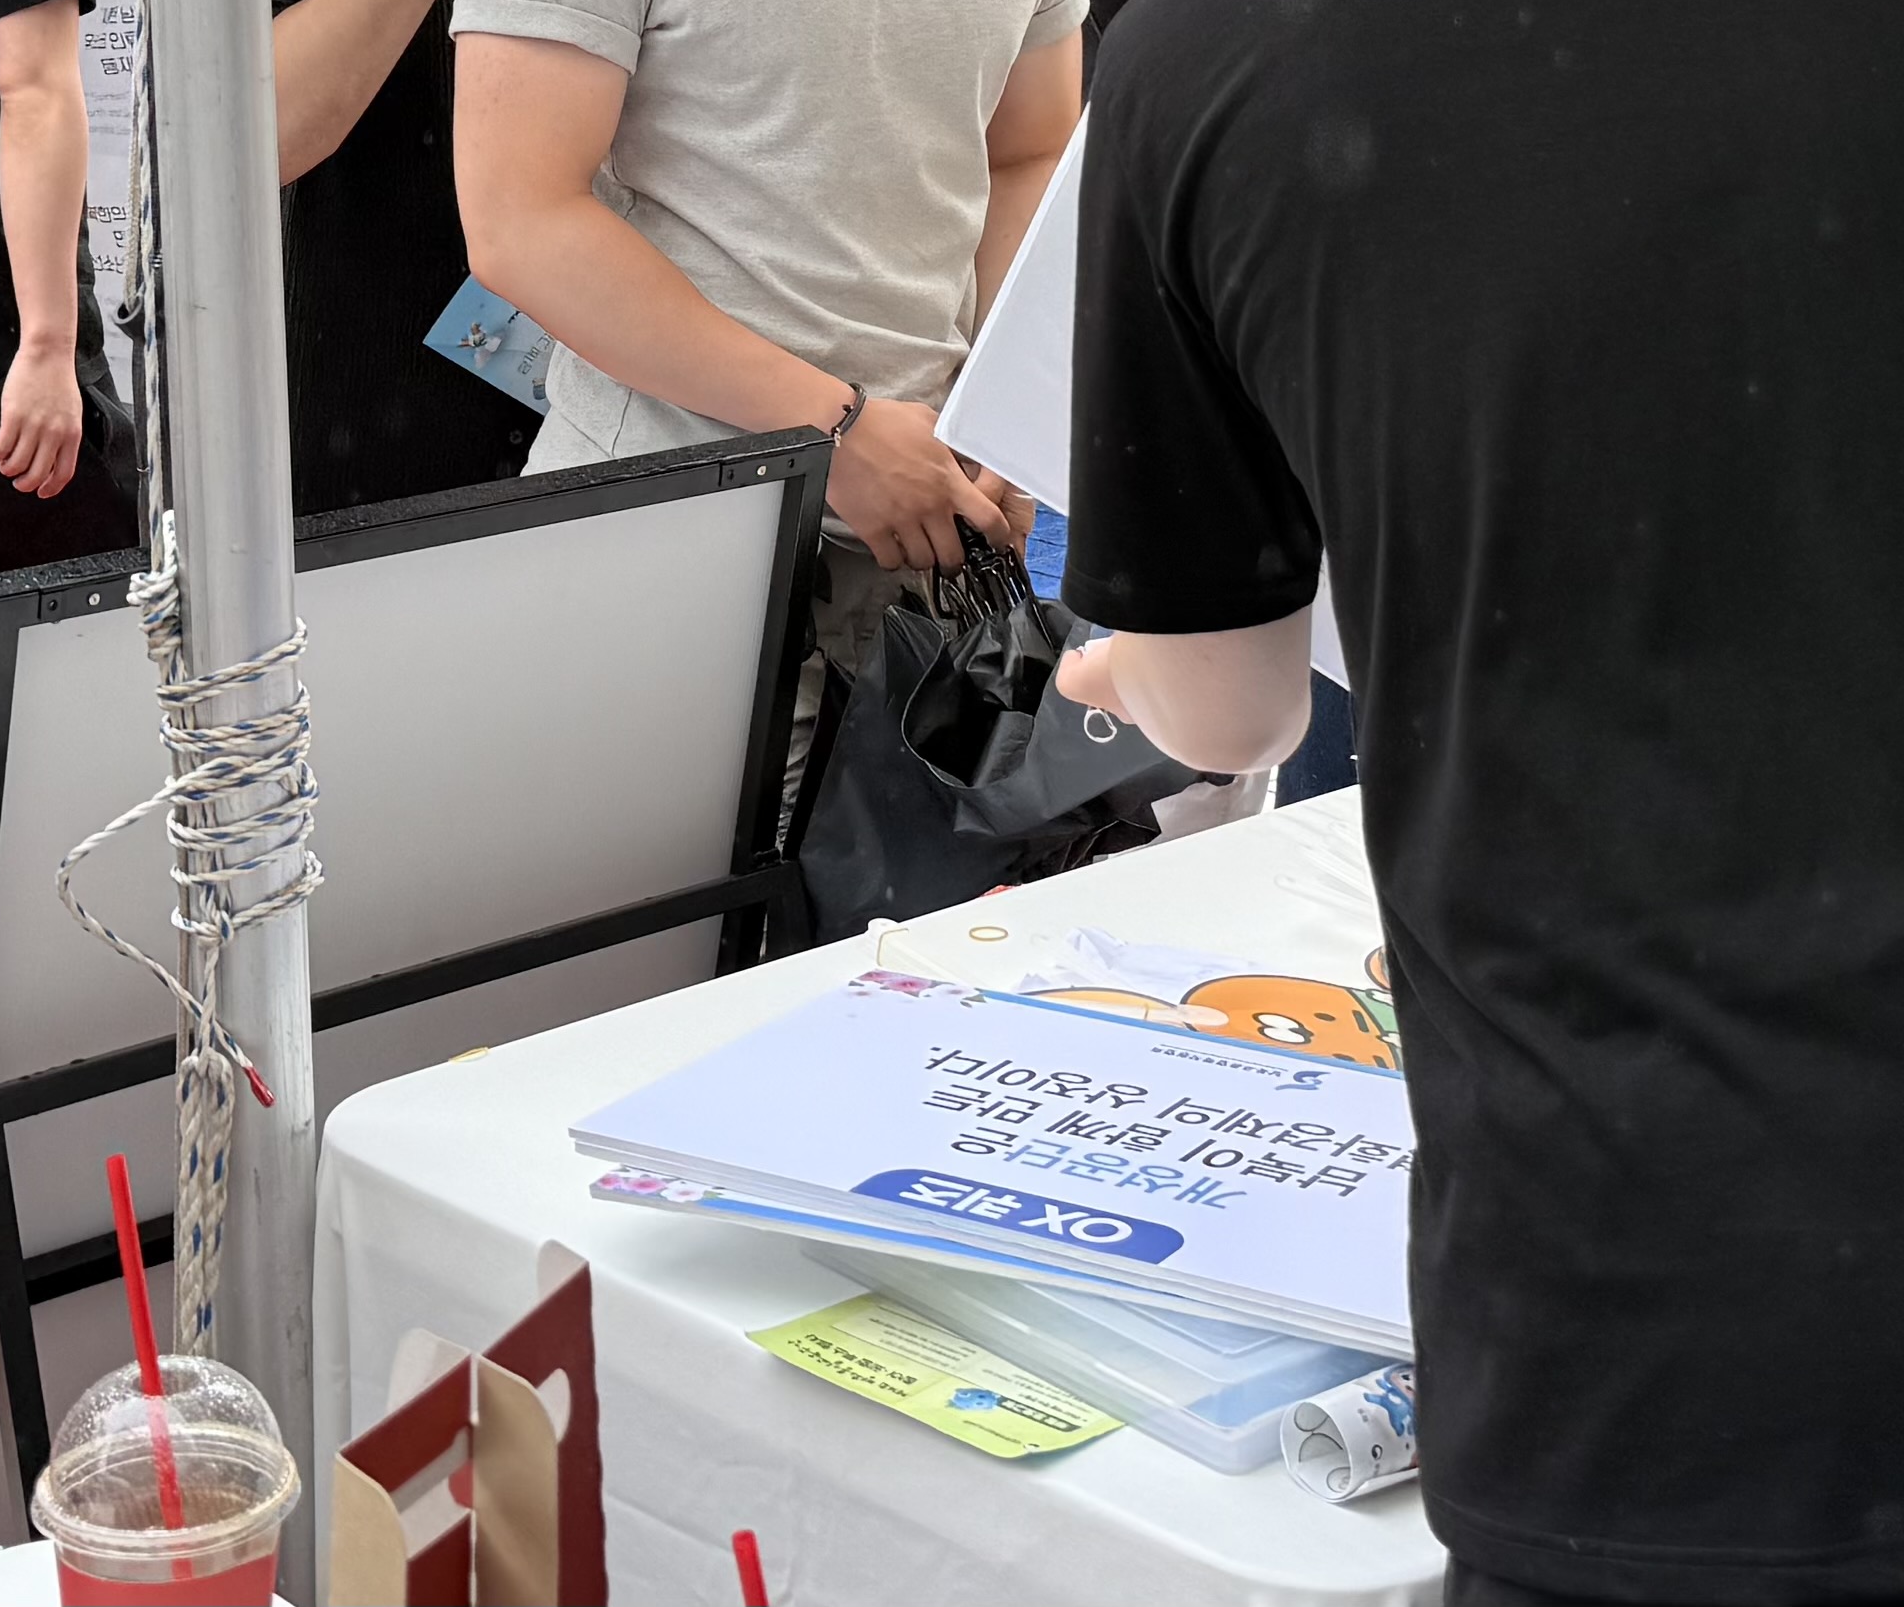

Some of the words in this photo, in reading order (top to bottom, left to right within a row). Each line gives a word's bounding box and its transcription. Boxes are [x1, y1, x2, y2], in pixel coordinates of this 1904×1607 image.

[921, 1079, 1034, 1127] 만든
[925, 1044, 1151, 1114] 상징이다.
[1044, 1109, 1173, 1156] 함께
[950, 1124, 1249, 1211] 개성공단은
[1182, 1133, 1364, 1199] 남북이
[897, 1172, 1026, 1222] 퀴즈
[1019, 1199, 1136, 1246] OX
